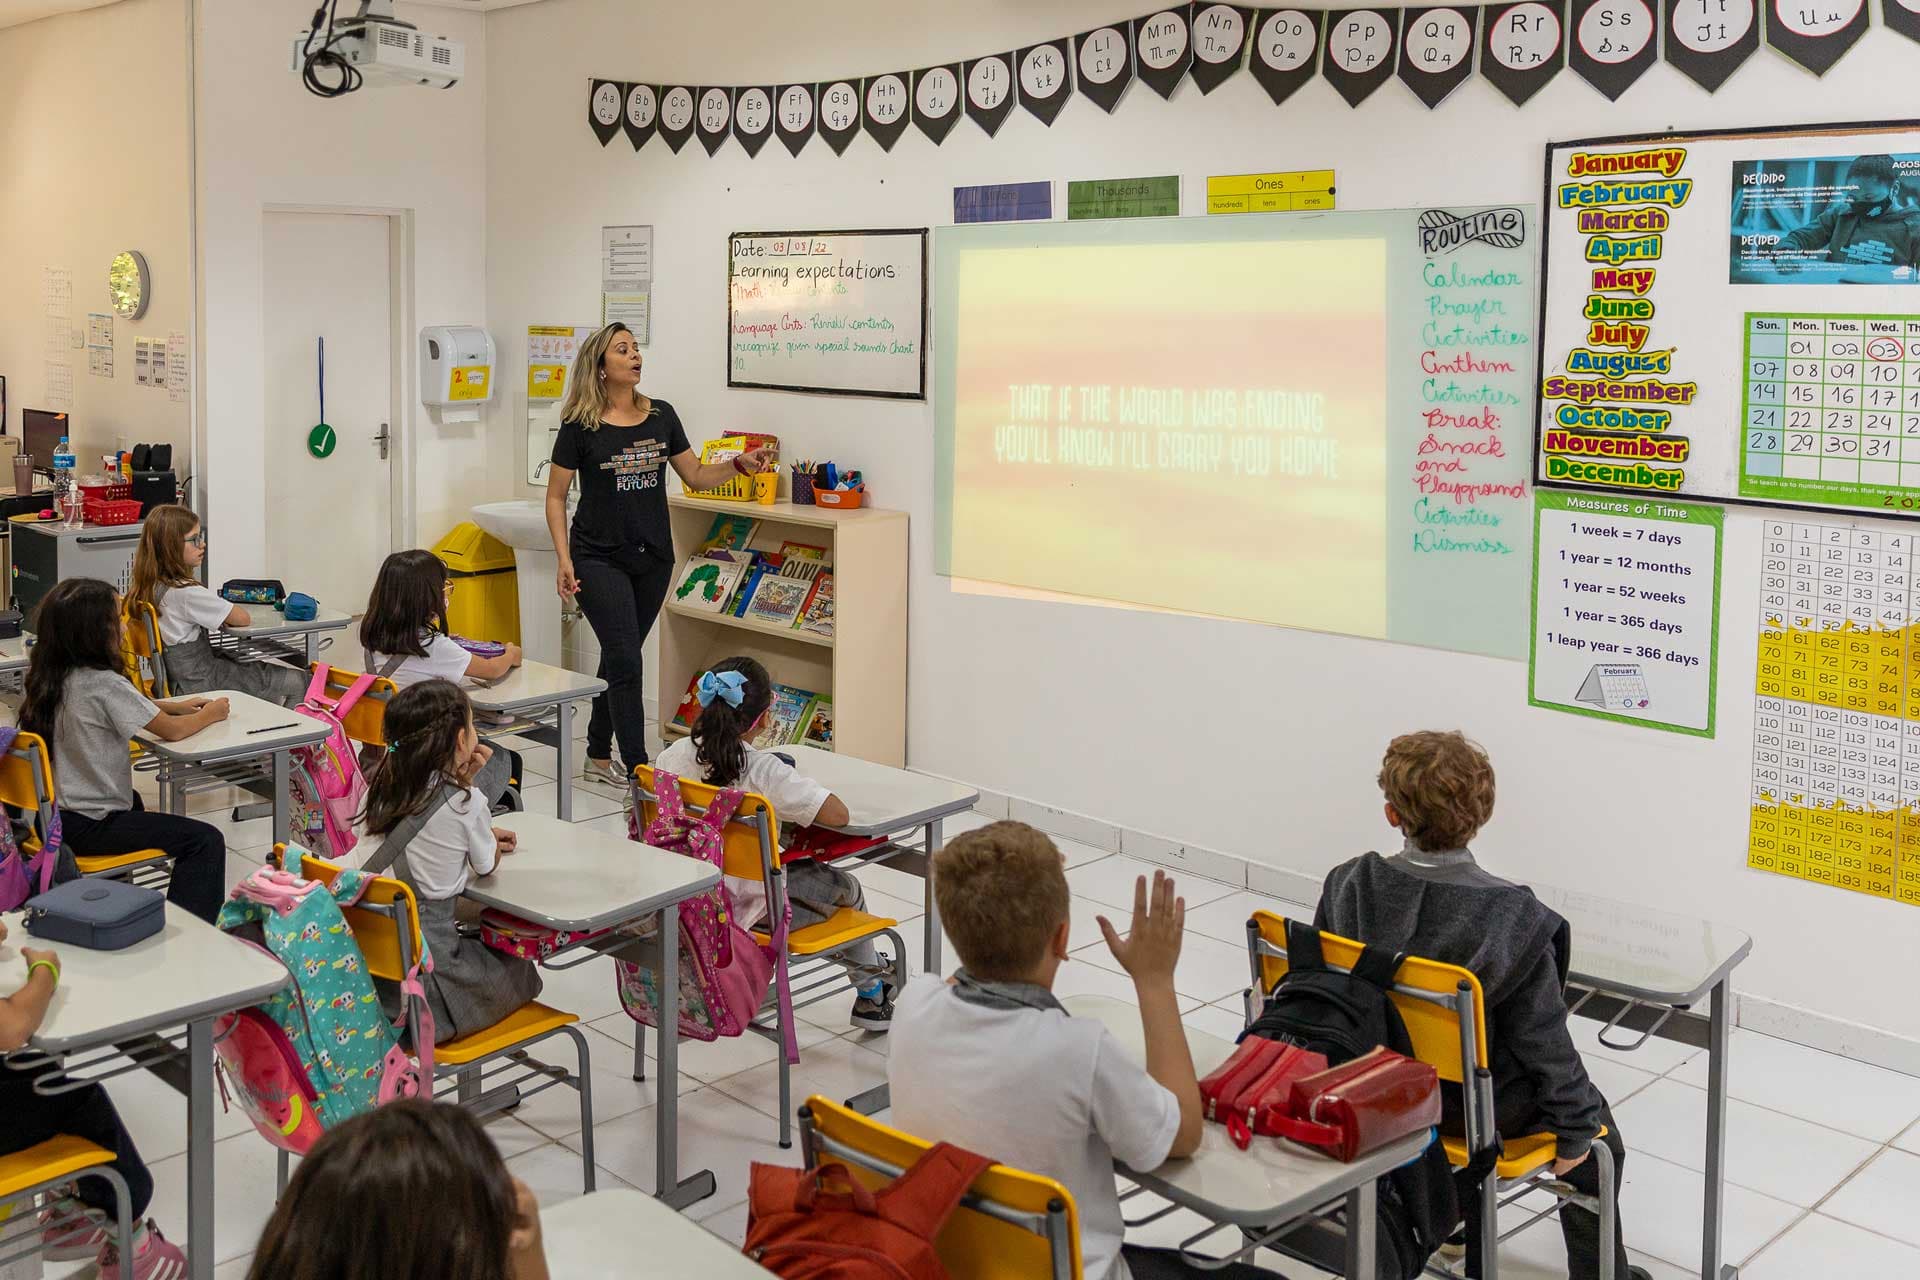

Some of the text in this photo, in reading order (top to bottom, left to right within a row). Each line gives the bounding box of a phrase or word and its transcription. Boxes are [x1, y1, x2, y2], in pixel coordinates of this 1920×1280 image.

[1571, 152, 1683, 174] January
[1256, 179, 1283, 190] Ones
[1743, 173, 1785, 185] DECIDIDO
[1098, 185, 1149, 197] Thousands
[1562, 183, 1688, 205] February
[1213, 200, 1243, 209] hundreds
[1581, 211, 1664, 230] March
[734, 240, 767, 256] Date:
[1589, 238, 1658, 261] April
[1741, 234, 1780, 246] DECIDED
[732, 261, 788, 287] Learning
[1424, 262, 1522, 287] Calendar
[1594, 271, 1653, 292] May
[1425, 295, 1505, 324] Prayer
[1588, 299, 1650, 316] June
[1423, 320, 1528, 347] Activities
[1591, 325, 1647, 349] July
[1830, 323, 1858, 331] Tues.
[1871, 324, 1899, 332] Wed.
[1791, 341, 1898, 357] 01 02 03
[1422, 351, 1516, 373] Anthem
[1571, 353, 1666, 376] August
[1754, 363, 1897, 382] 07 08 09 10
[455, 370, 462, 383] 2
[1547, 380, 1693, 400] September
[1754, 384, 1896, 405] 14 15 16 17
[1009, 385, 1323, 433] THAT IF THE WORLD WAS ENDING
[1423, 406, 1501, 429] Break:
[1560, 407, 1667, 429] October
[1753, 410, 1891, 431] 21 22 23 24
[995, 425, 1050, 464] YOU'LL
[1058, 427, 1114, 467] KNOW
[1158, 432, 1222, 472] CARRY
[1231, 435, 1271, 476] YOU
[1280, 437, 1338, 479] HOME
[1418, 434, 1505, 457] Snack
[1547, 433, 1686, 458] November
[1751, 433, 1890, 456] 28 29 30 31
[1416, 458, 1468, 472] and
[1549, 459, 1680, 488] December
[617, 479, 657, 491] FUTURO
[1412, 473, 1527, 504] Playground
[1567, 497, 1687, 518] Measures of Time
[1414, 529, 1513, 553] Dismiss
[1571, 523, 1681, 545] 1 week 7 days
[1560, 551, 1691, 575] 1 year 12 months
[1768, 560, 1903, 584] 20 22 24
[1563, 579, 1686, 604] 1 year 52 weeks
[1563, 607, 1682, 633] 1 year 365 days
[1547, 633, 1699, 666] 1 leap year 366 days
[1759, 700, 1898, 731] 100 102 104
[1751, 855, 1890, 894] 190 194
